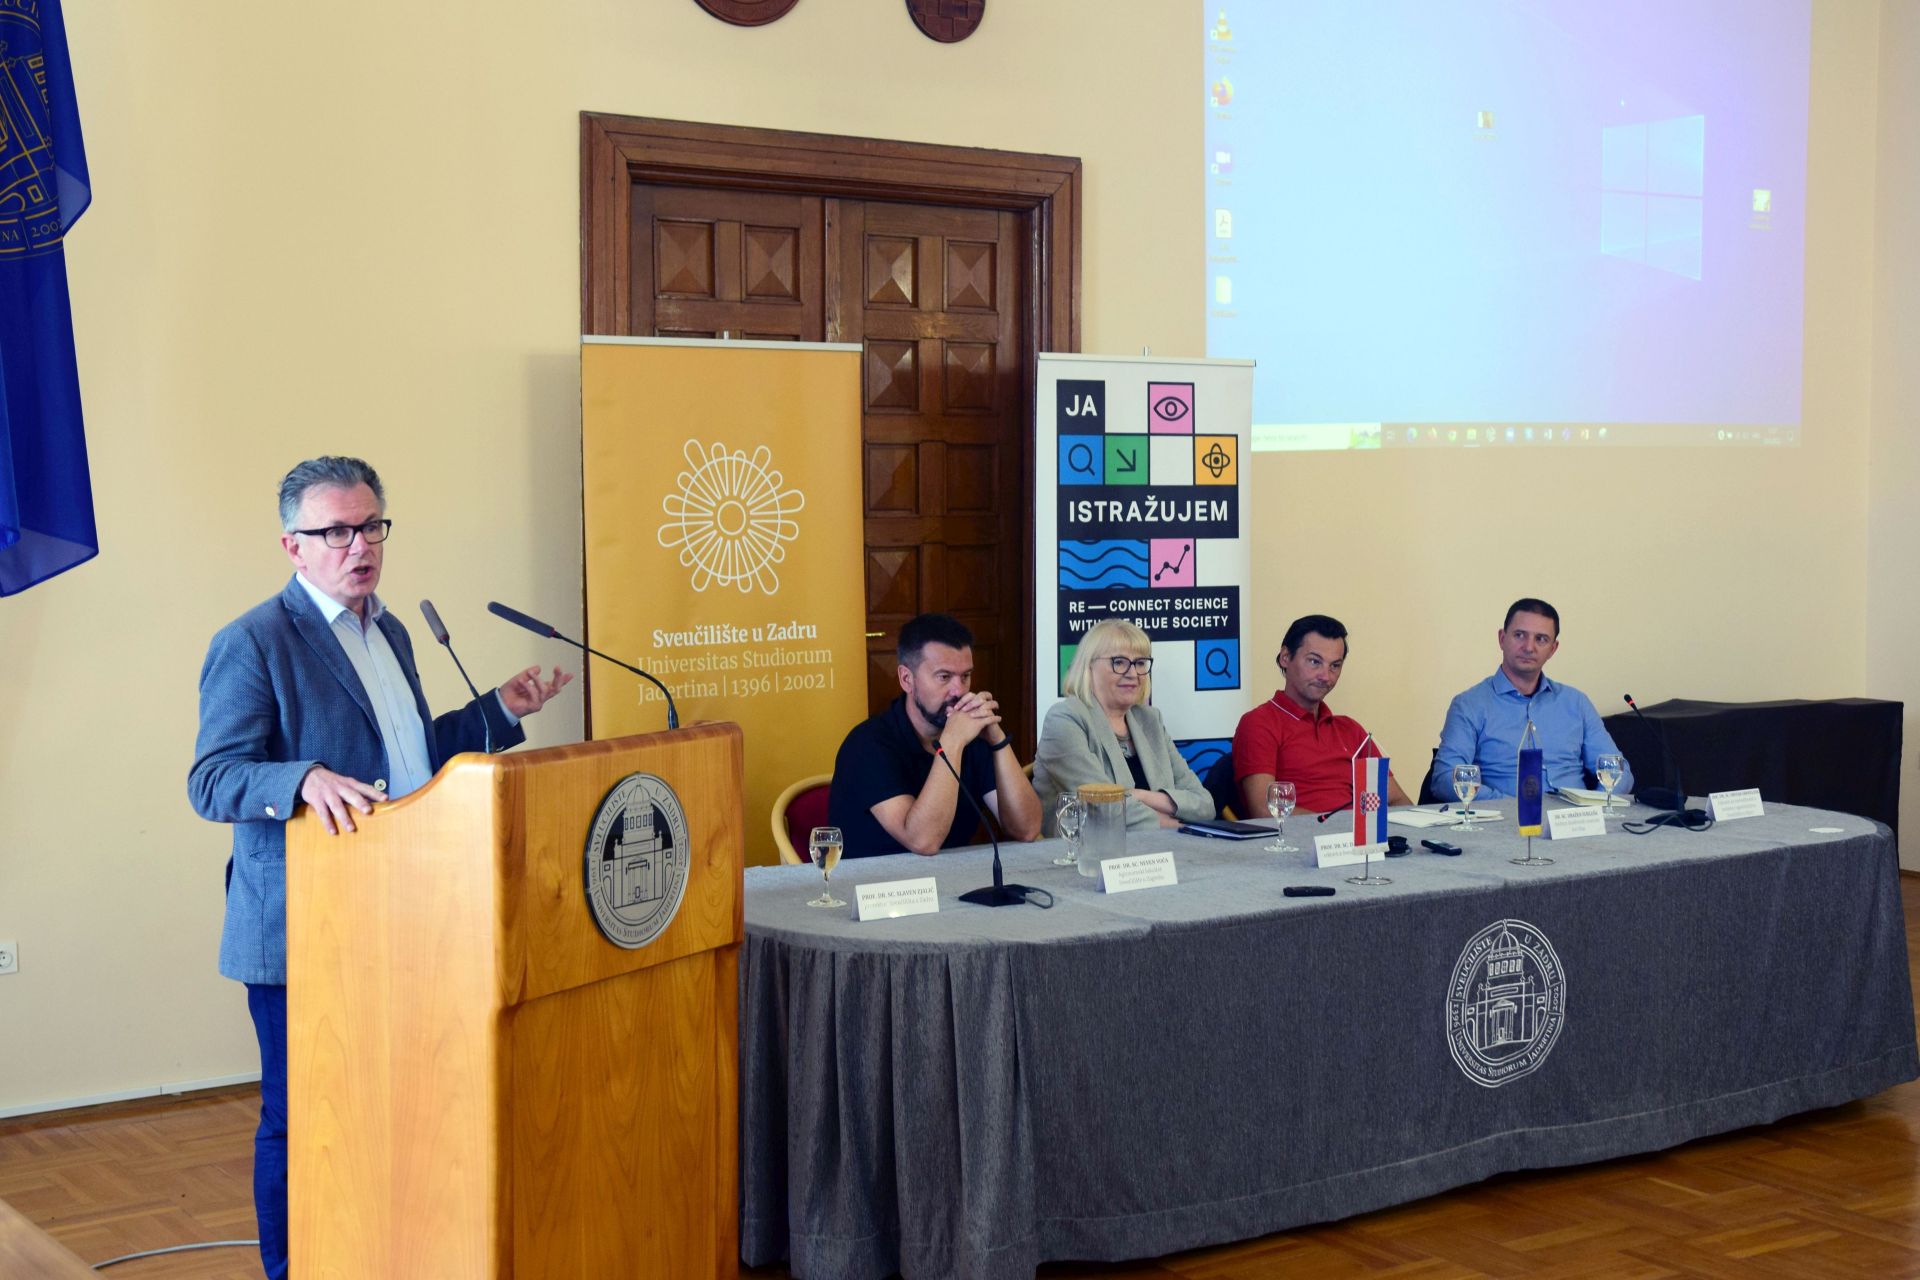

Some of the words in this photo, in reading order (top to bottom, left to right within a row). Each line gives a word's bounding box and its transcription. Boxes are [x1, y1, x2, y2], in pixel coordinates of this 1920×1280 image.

[1065, 394, 1098, 417] JA
[1069, 495, 1229, 523] ISTRAŽUJEM
[1069, 601, 1085, 613] RE
[1109, 599, 1171, 612] CONNECT
[1174, 597, 1229, 610] SCIENCE
[652, 624, 748, 648] Sveučilište
[752, 629, 763, 642] u
[767, 620, 817, 642] Zadru
[1135, 616, 1168, 629] BLUE
[1172, 615, 1229, 629] SOCIETY
[637, 652, 737, 675] Universitas
[743, 647, 833, 669] Studiorum
[637, 679, 718, 706] Jadertina
[731, 674, 771, 698] 1396
[783, 673, 825, 691] 2002
[1524, 934, 1532, 944] U
[1533, 941, 1557, 980] ZADRU
[1452, 1003, 1460, 1028] 1396
[1454, 1031, 1487, 1076] UNIVERSITAS
[1526, 1017, 1557, 1064] JADERTINA
[1487, 1058, 1528, 1078] STUDIORUM
